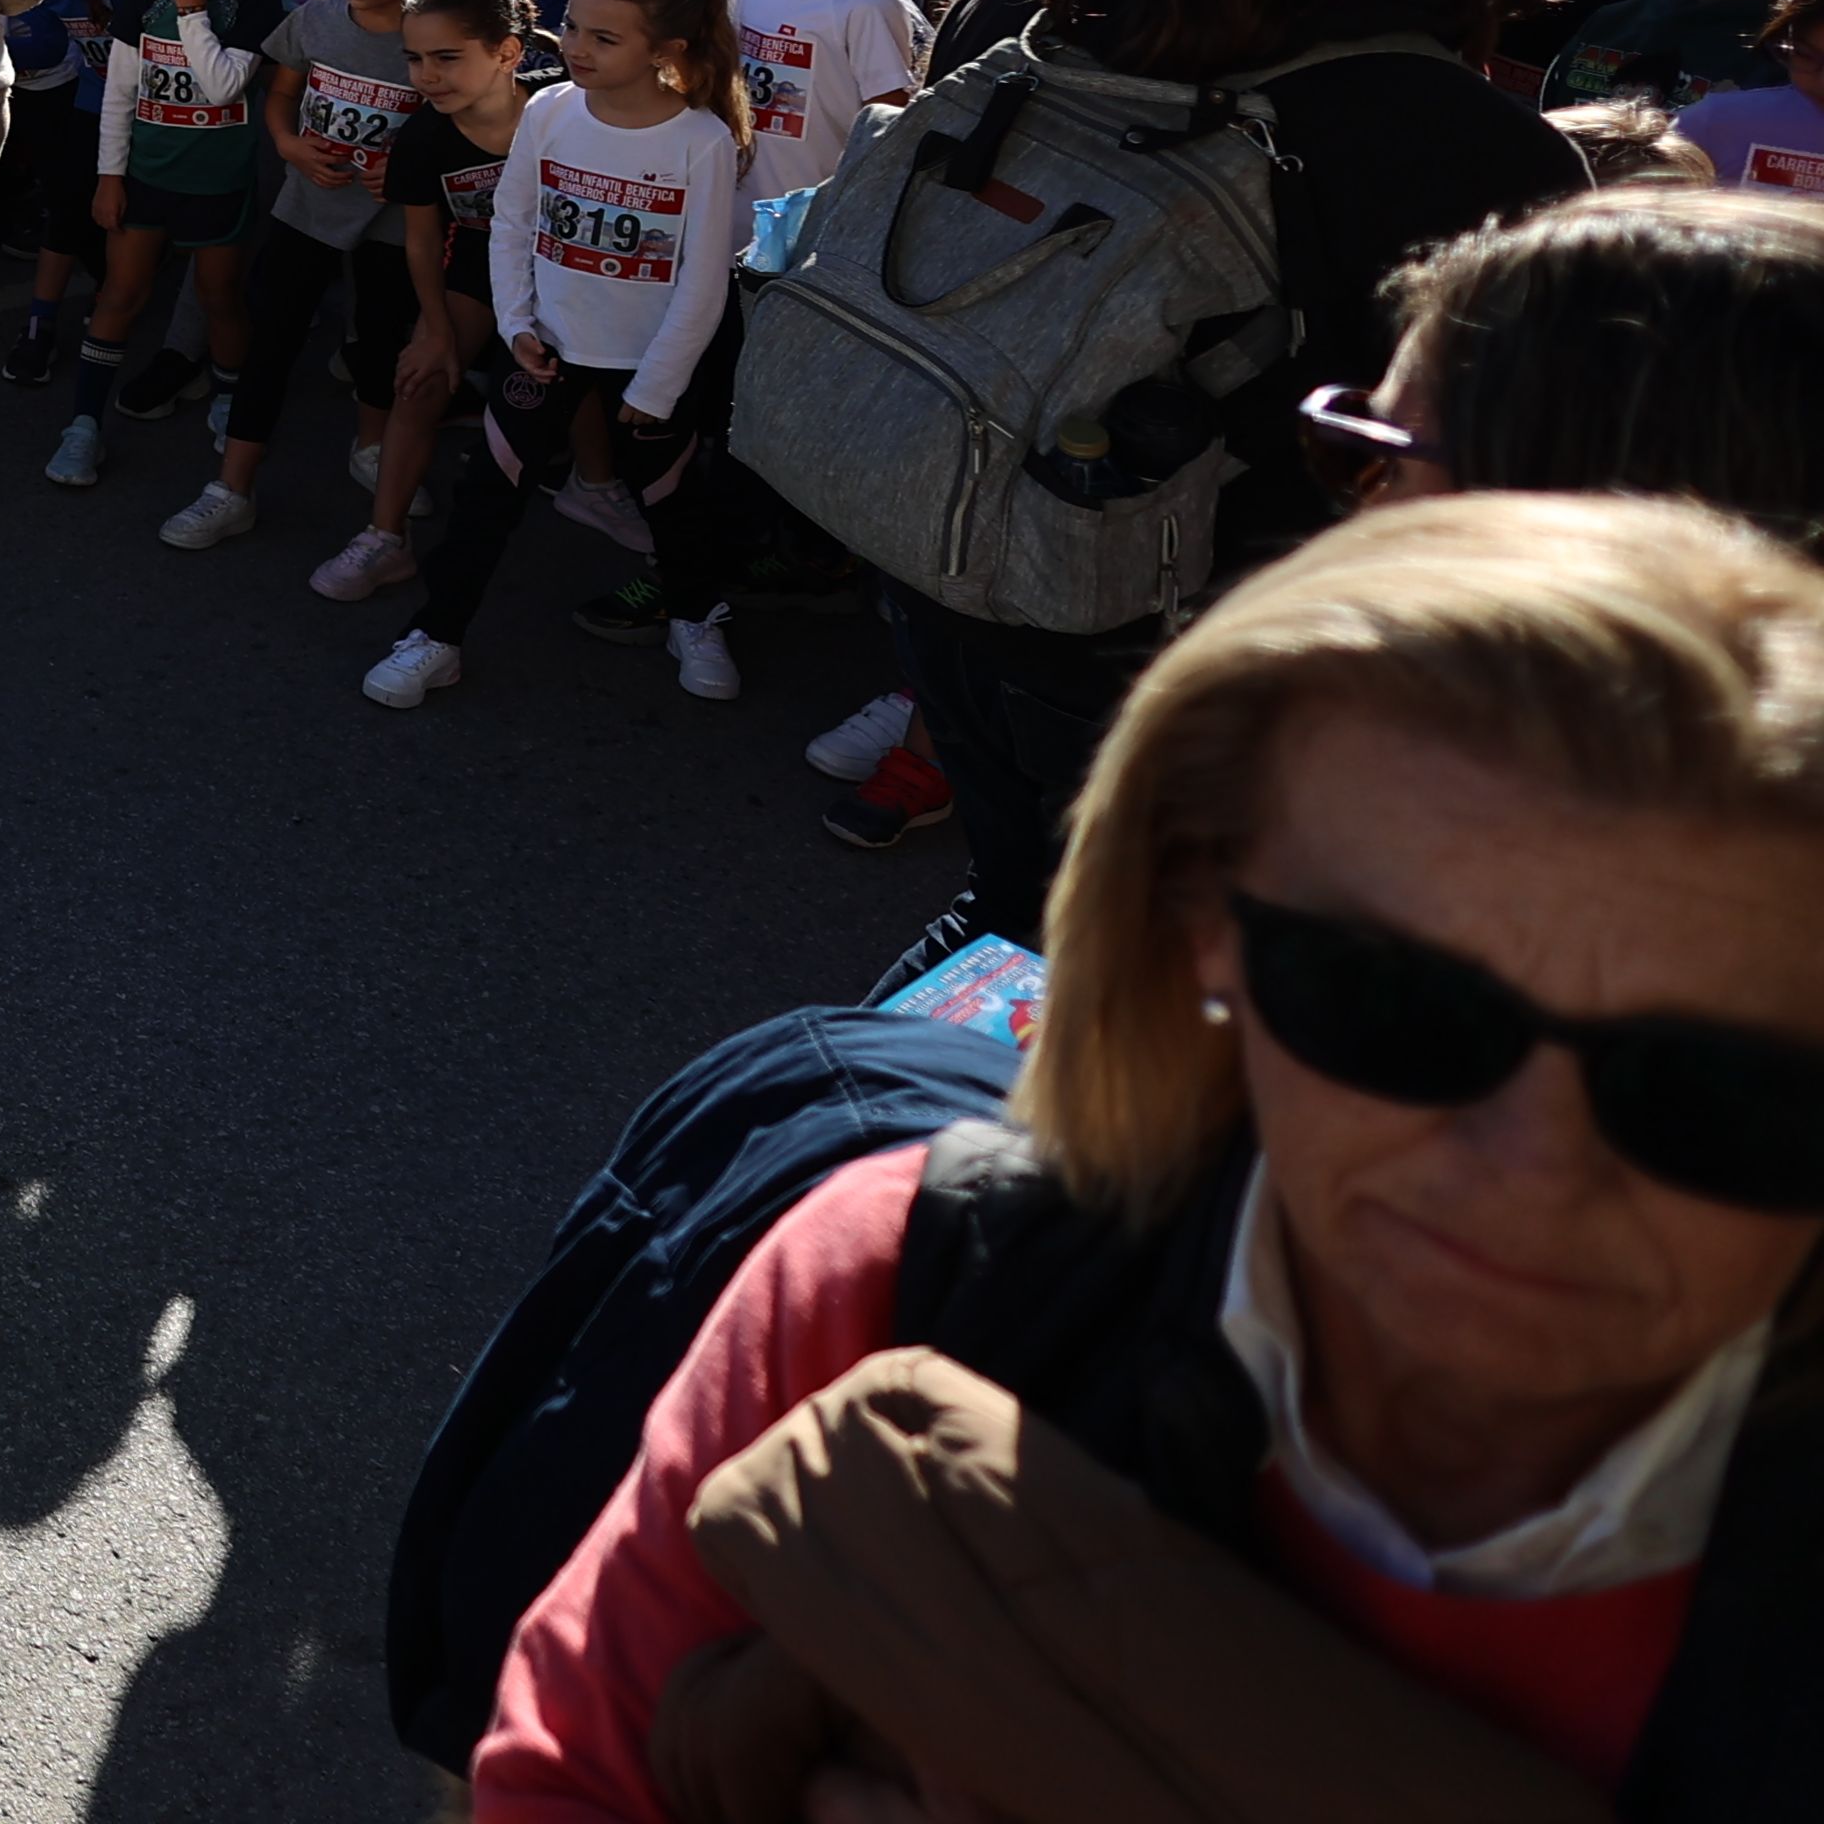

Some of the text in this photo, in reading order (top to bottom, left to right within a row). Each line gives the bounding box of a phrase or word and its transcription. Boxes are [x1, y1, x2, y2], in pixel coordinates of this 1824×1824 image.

[319, 81, 401, 111] BOMBEROS DE JEREZ
[340, 78, 375, 95] INFANTIL
[322, 101, 389, 147] 132
[1766, 155, 1824, 176] CARRER
[549, 163, 675, 202] CARRERA INFANTIL BENÉFICA
[558, 180, 652, 211] BOMBEROS DE JEREZ
[556, 199, 641, 253] 319
